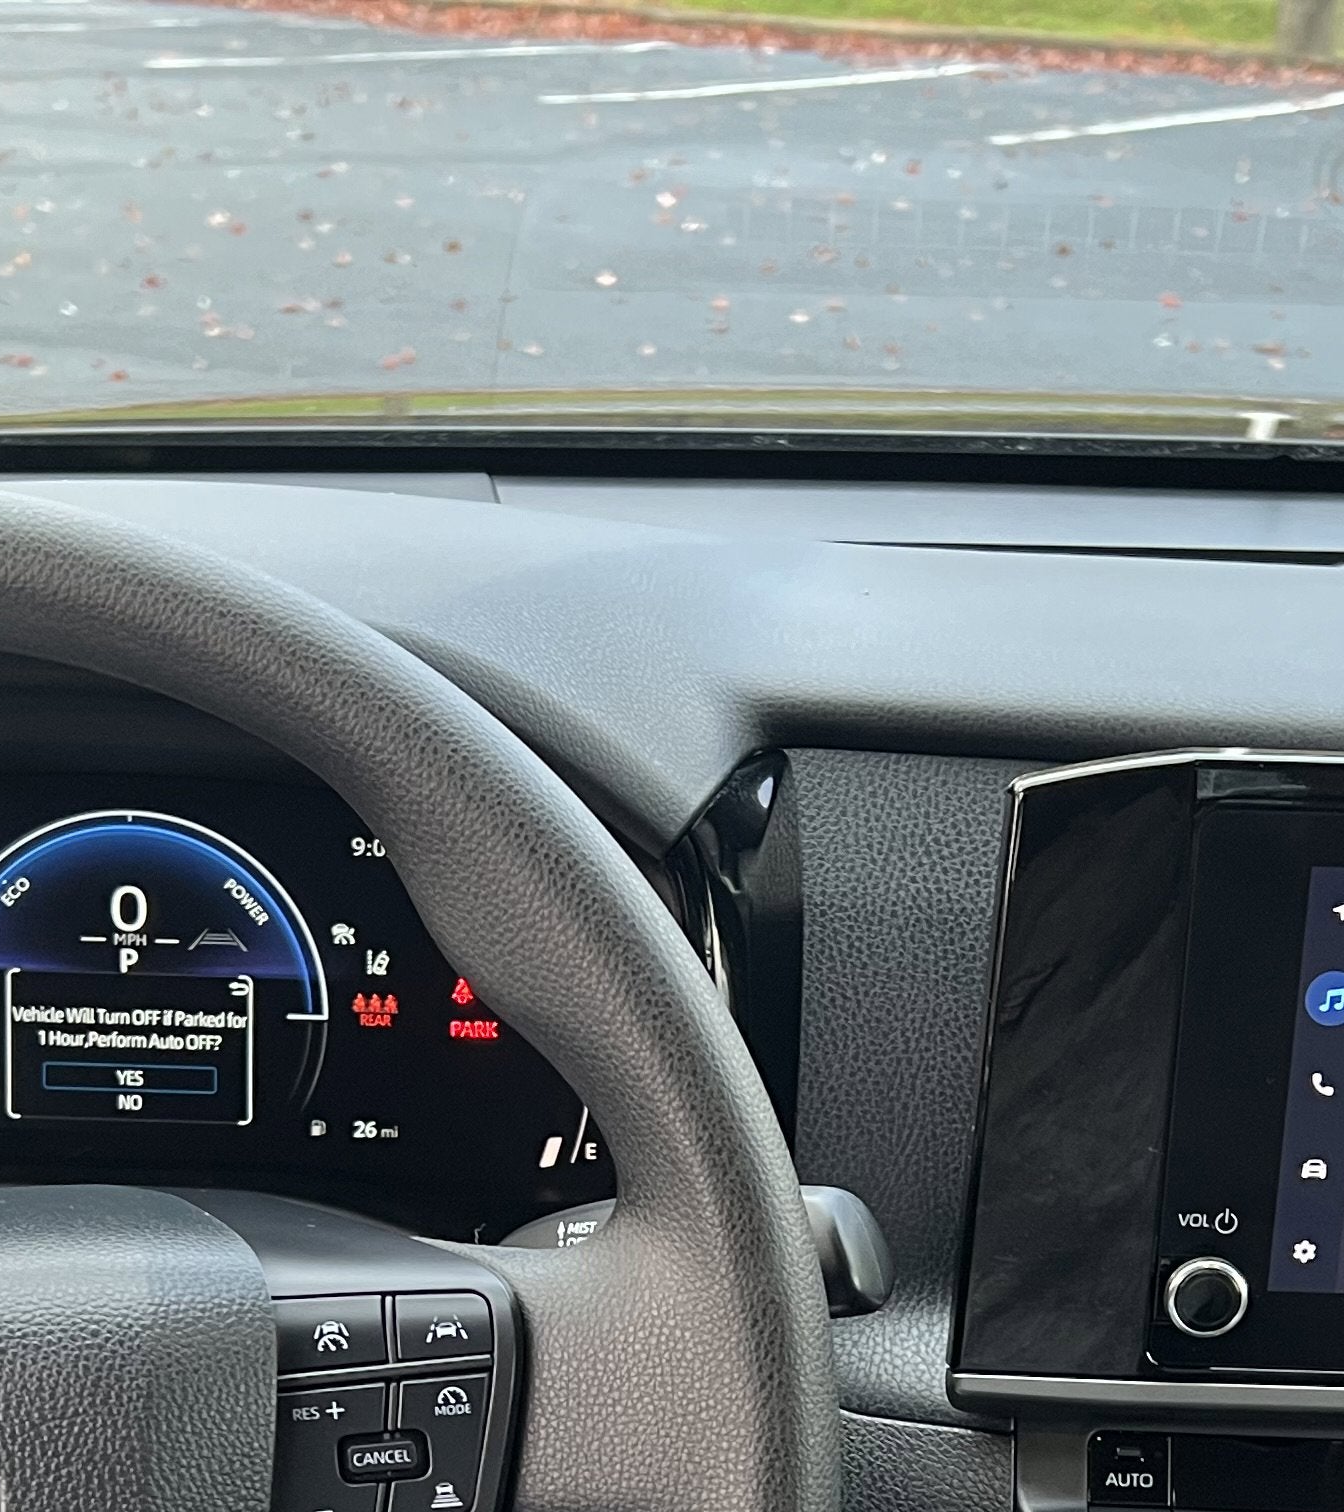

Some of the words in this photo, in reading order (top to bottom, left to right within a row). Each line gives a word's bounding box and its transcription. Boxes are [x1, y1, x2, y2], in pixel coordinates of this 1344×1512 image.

[0, 877, 31, 908] ECO
[111, 885, 148, 931] 0
[223, 878, 269, 926] POWER
[113, 933, 147, 947] MPH
[120, 950, 138, 973] P
[12, 1006, 64, 1024] Vehicle
[66, 1007, 95, 1024] Will
[96, 1008, 130, 1025] Turn
[132, 1010, 161, 1025] OFF
[163, 1010, 173, 1026] if
[175, 1011, 225, 1028] Parked
[227, 1012, 248, 1028] for
[360, 1014, 391, 1027] REAR
[450, 1021, 498, 1038] PARK
[38, 1031, 46, 1045] 1
[149, 1033, 184, 1049] Auto
[186, 1035, 222, 1050] OFF?
[116, 1070, 144, 1086] YES
[117, 1095, 143, 1110] NO
[353, 1122, 377, 1139] 26
[381, 1125, 398, 1138] mi
[584, 1143, 597, 1160] E
[567, 1221, 597, 1234] MIST
[1178, 1213, 1210, 1228] VOL
[292, 1407, 320, 1421] RES
[434, 1403, 472, 1416] MODE
[353, 1449, 412, 1467] CANCEL
[1105, 1472, 1154, 1489] AUTO
